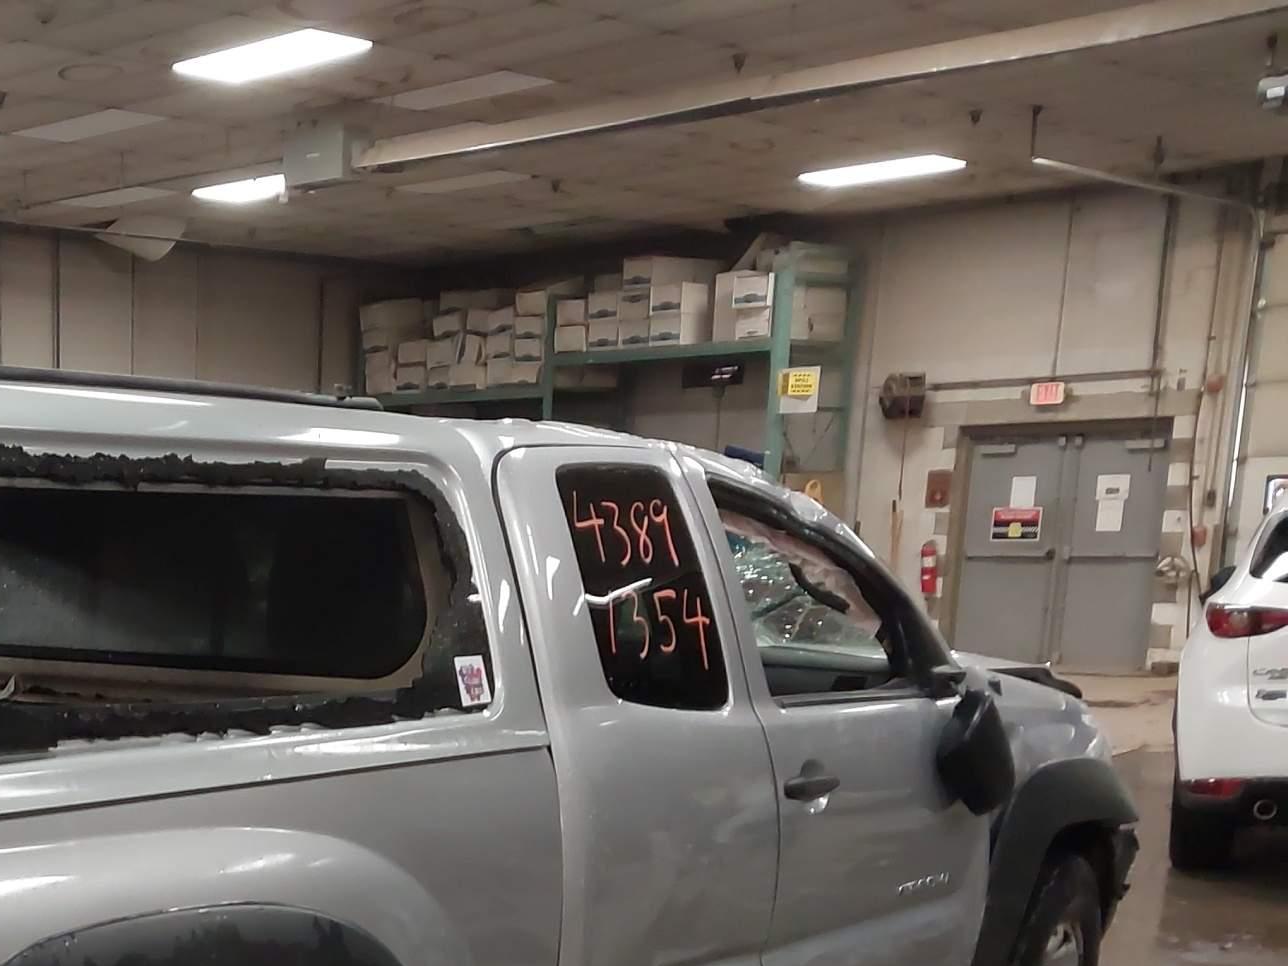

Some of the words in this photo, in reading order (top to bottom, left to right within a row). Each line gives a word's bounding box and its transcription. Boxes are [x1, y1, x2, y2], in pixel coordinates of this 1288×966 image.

[1036, 384, 1059, 401] EXIT
[573, 490, 679, 567] 4389
[608, 588, 710, 670] 1354
